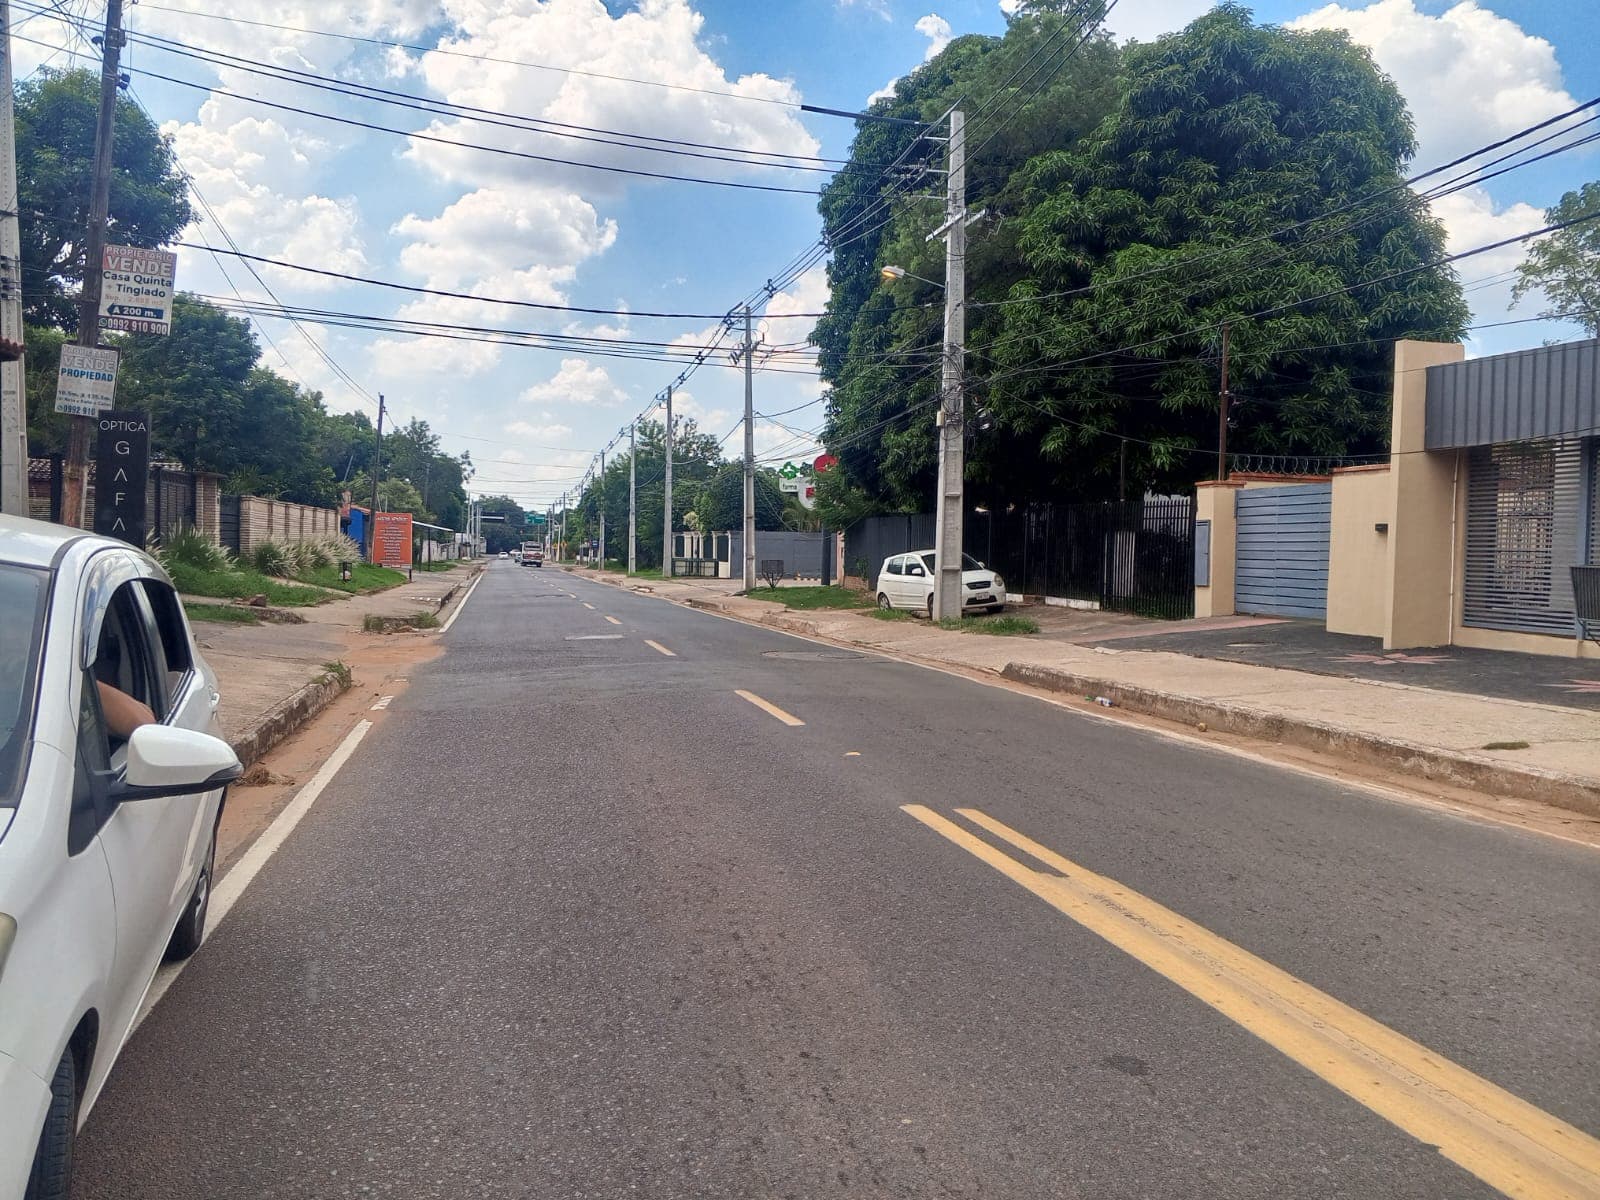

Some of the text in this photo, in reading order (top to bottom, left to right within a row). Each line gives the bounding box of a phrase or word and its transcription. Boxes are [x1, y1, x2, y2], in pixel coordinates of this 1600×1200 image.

[106, 246, 173, 261] PROPIETARIO
[107, 256, 172, 277] VENDE
[103, 271, 172, 287] Casa Quinta
[116, 284, 166, 298] Tinglado
[113, 306, 120, 314] A
[123, 307, 142, 316] 200
[107, 318, 167, 335] 0992 910 900
[64, 356, 115, 371] VENDE
[61, 367, 113, 382] PROPIEDAD
[99, 420, 146, 432] OPTICA
